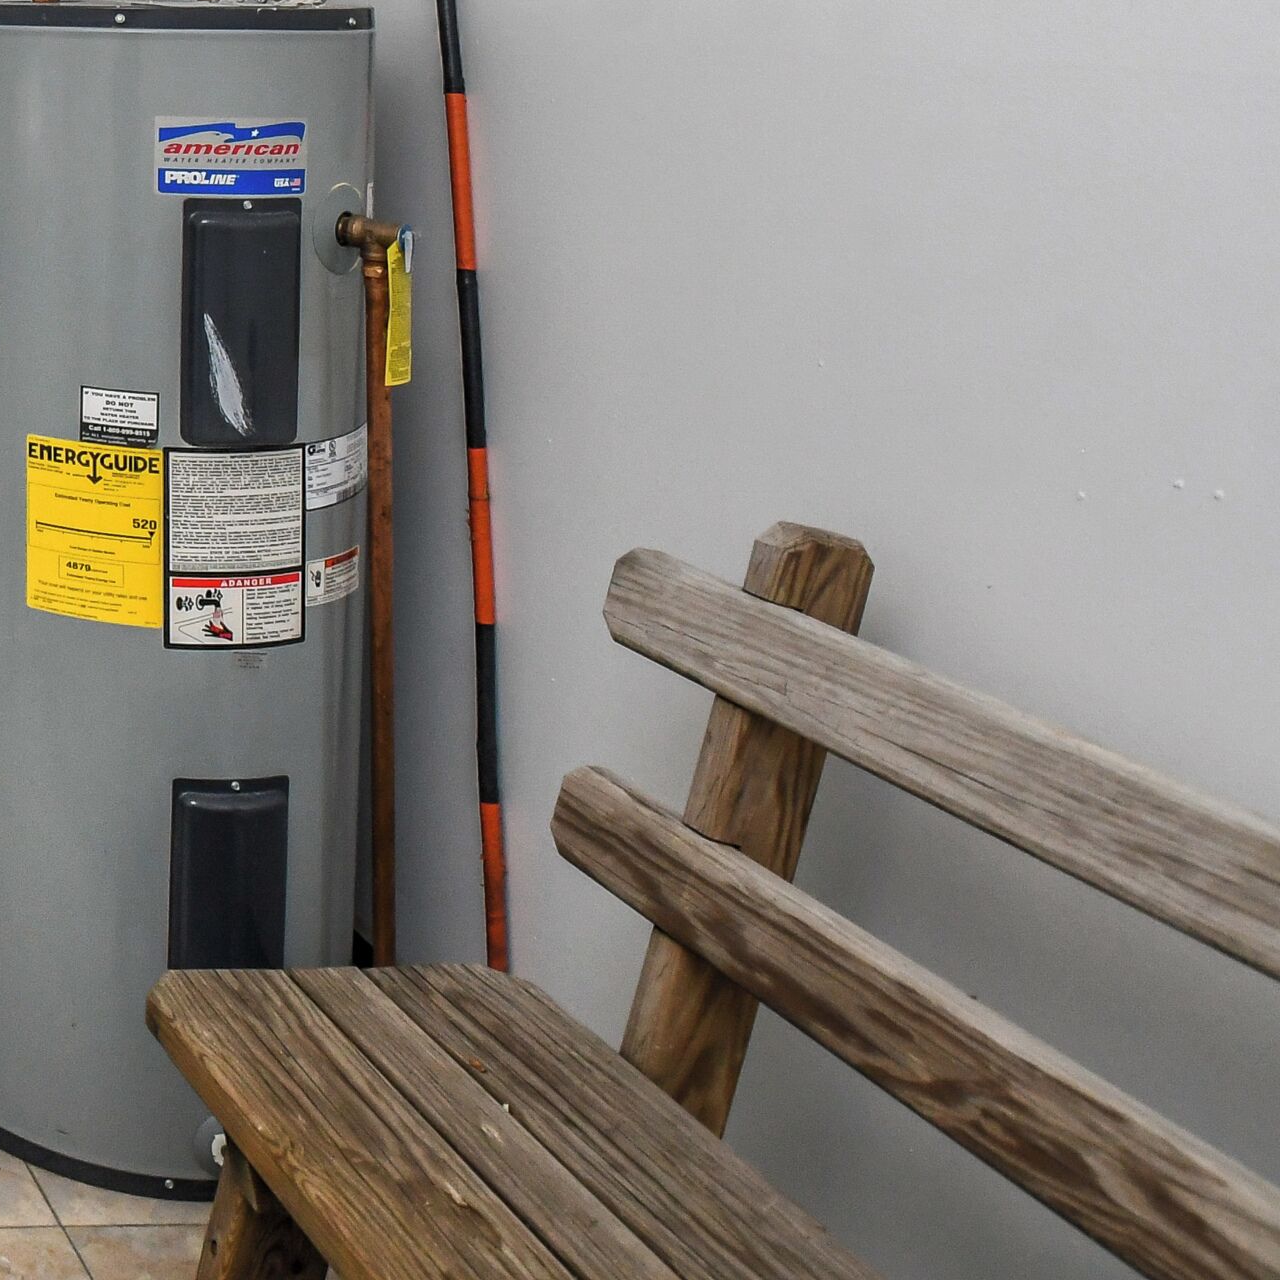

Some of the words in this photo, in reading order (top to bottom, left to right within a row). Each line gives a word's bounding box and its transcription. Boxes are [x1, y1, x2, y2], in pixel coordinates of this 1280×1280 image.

[163, 142, 300, 156] american
[164, 170, 237, 186] PROLINE
[28, 441, 160, 478] ENERGYGUIDE
[132, 518, 158, 531] 520
[65, 561, 92, 572] 4879
[228, 577, 272, 587] DANGER
